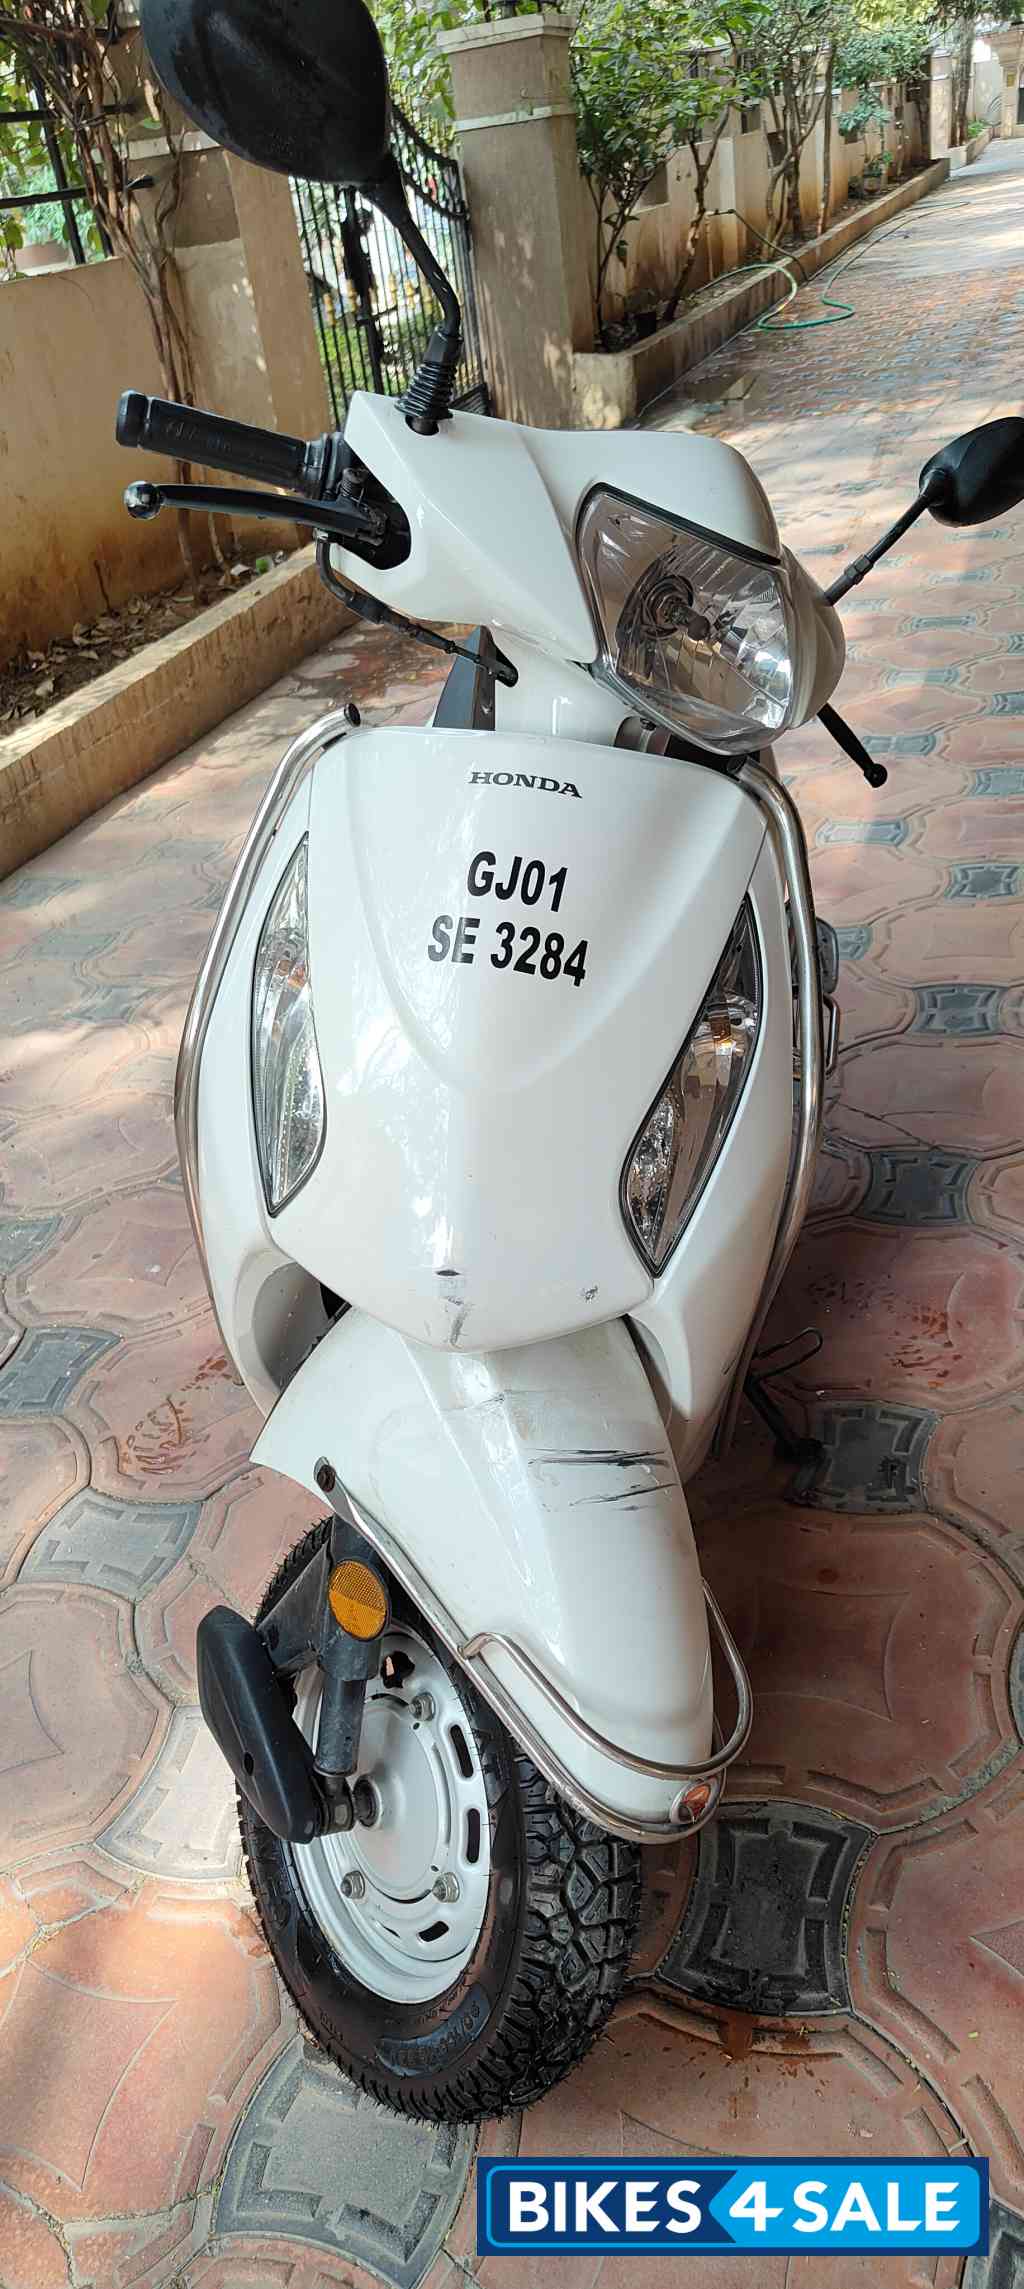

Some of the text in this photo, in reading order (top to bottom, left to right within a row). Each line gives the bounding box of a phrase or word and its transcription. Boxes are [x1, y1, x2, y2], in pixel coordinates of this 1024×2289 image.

[469, 771, 583, 799] HONDA
[467, 851, 568, 912] GJ01
[427, 915, 589, 987] SE 3284
